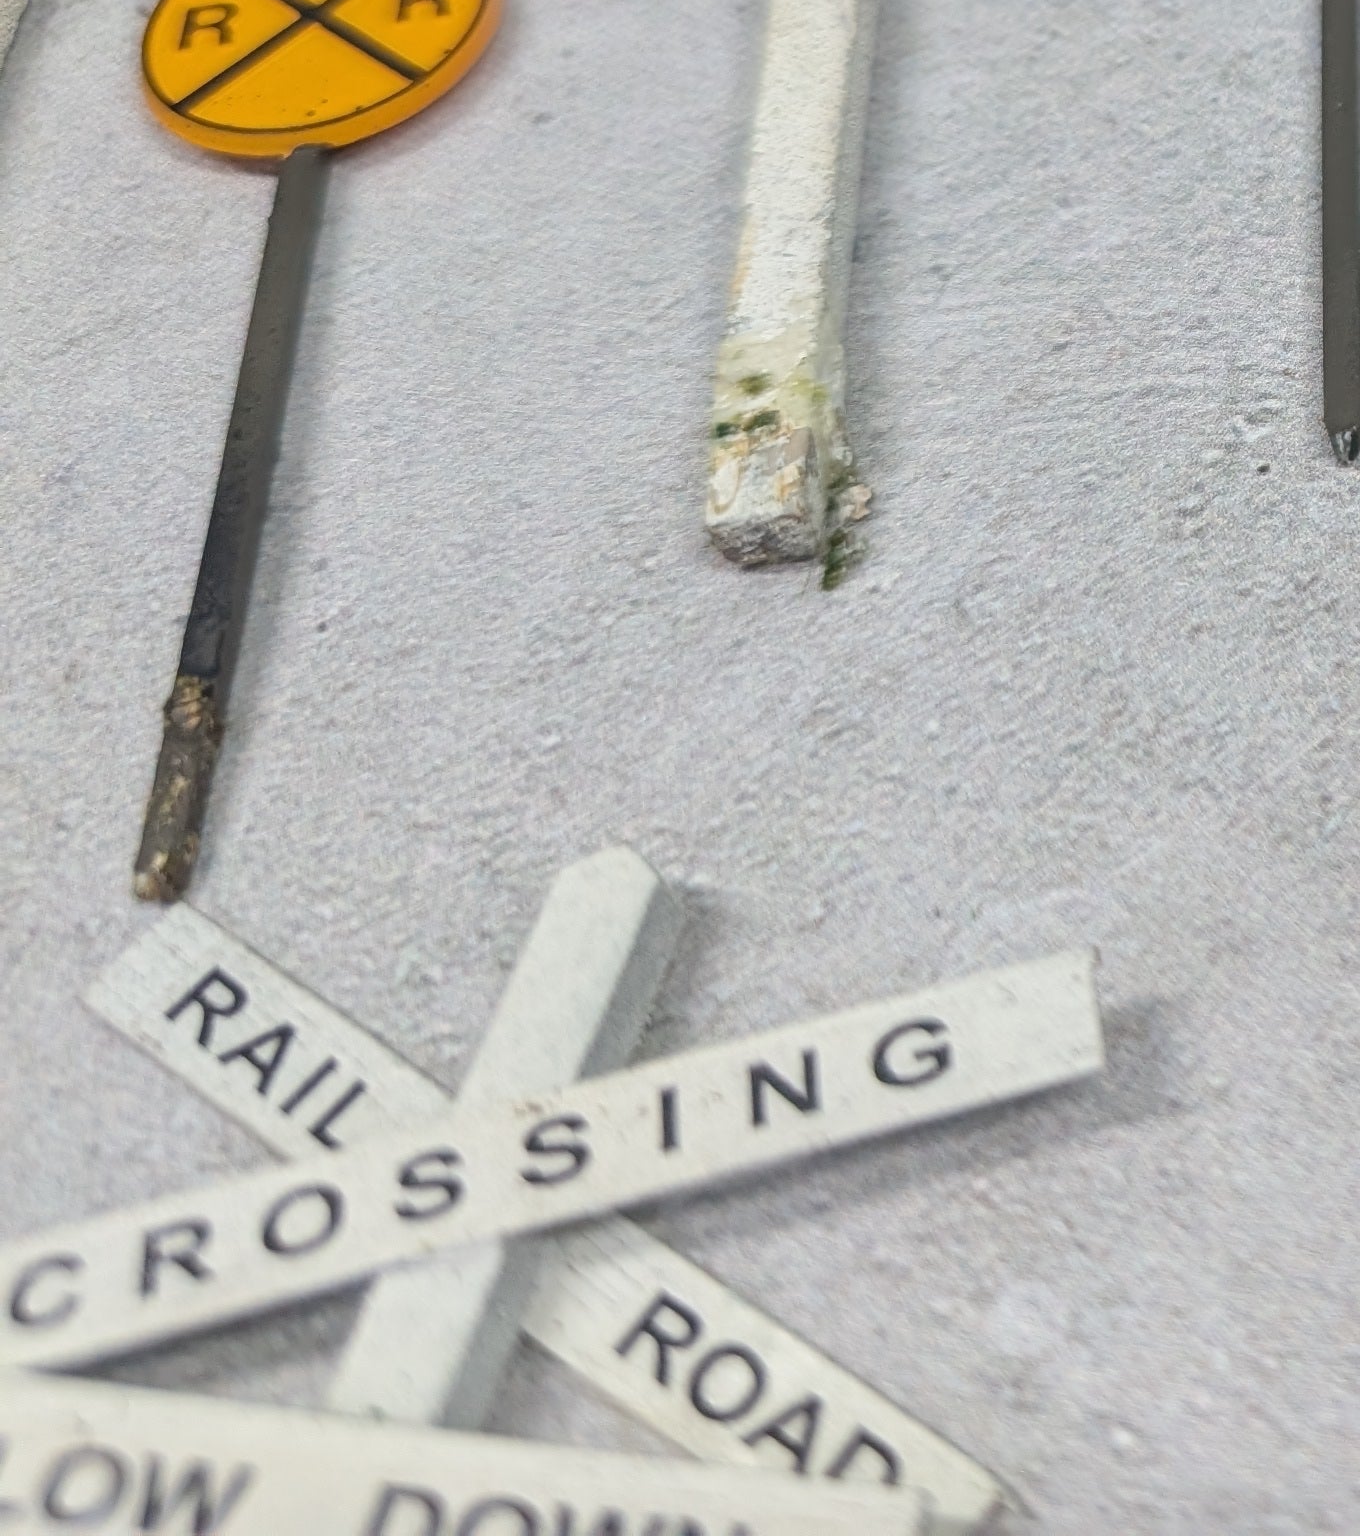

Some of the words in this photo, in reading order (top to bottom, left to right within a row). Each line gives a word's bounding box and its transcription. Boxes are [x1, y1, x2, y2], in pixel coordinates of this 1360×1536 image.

[177, 2, 240, 52] R
[164, 964, 370, 1154] RAIL
[6, 1015, 955, 1333] CROSSING
